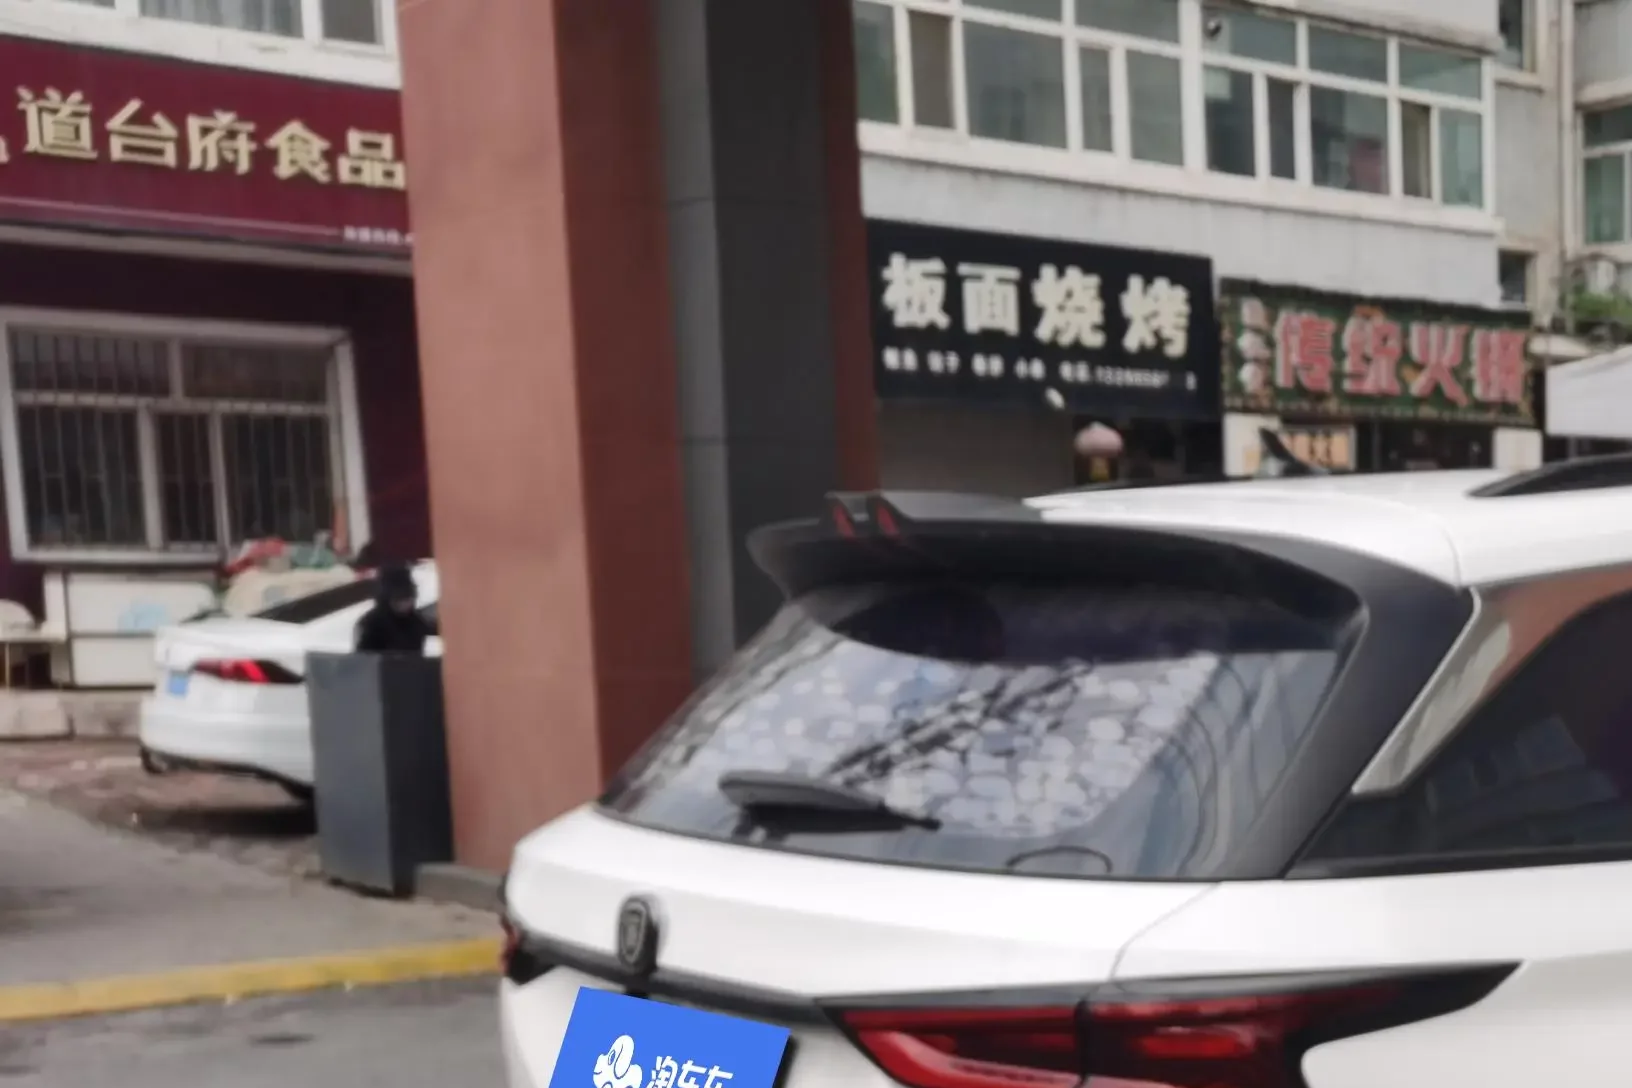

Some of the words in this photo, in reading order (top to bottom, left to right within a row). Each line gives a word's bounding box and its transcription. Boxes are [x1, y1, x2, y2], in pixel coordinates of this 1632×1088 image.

[0, 86, 406, 190] 道台府食品
[882, 252, 1191, 358] 板面烧烤
